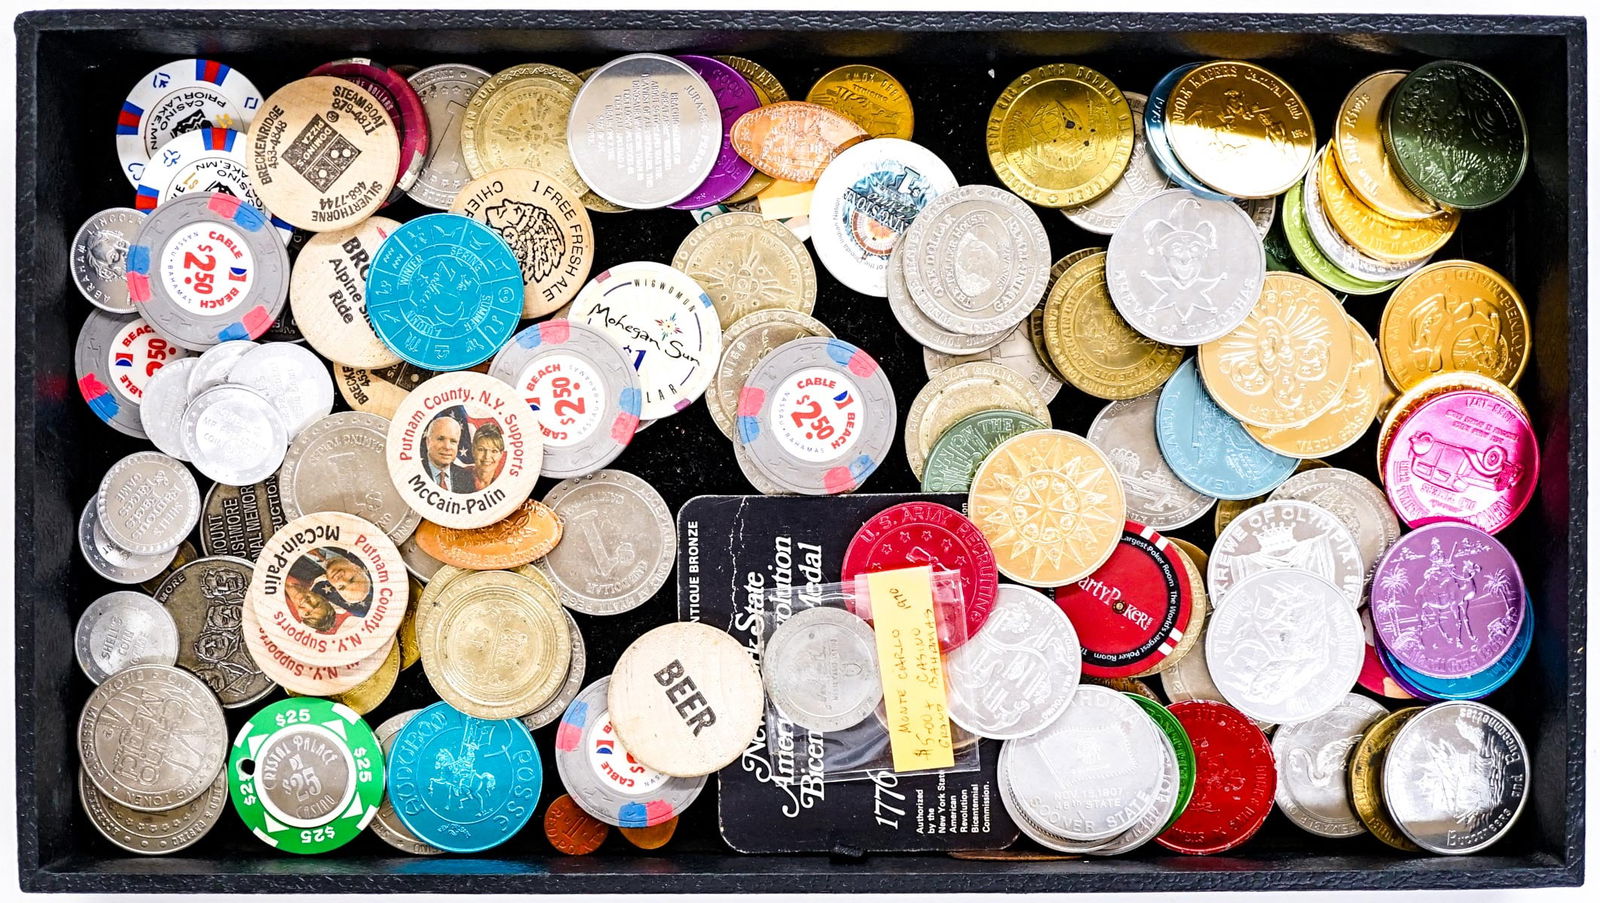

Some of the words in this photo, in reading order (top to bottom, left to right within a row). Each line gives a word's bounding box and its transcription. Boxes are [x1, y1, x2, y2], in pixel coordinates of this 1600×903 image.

[184, 91, 226, 108] PRIOR
[332, 85, 388, 129] STEAMBOAT
[366, 85, 394, 112] DOLLARS
[472, 82, 497, 107] SUN
[160, 99, 204, 131] CASINO
[301, 120, 325, 146] PIZZA
[331, 98, 376, 136] 879-4811
[150, 127, 158, 150] MN
[254, 104, 285, 186] BRECKENRIDGE
[267, 120, 288, 169] 453-4848
[296, 126, 333, 167] DOMINO'S
[196, 160, 218, 171] MN
[311, 180, 384, 223] SILVERTHORNE
[319, 181, 367, 211] 468-7744
[531, 180, 540, 193] 1
[542, 186, 578, 221] FREE
[86, 212, 145, 236] LINCOLN
[208, 230, 243, 260] CABLE
[449, 246, 484, 272] SPRING
[564, 224, 585, 277] FRESH
[328, 257, 363, 304] Alpine
[400, 255, 425, 286] WINTER
[794, 242, 816, 310] MOHEGA
[199, 287, 240, 309] BEACH
[328, 288, 354, 325] Ride
[542, 280, 568, 302] ALE
[465, 294, 492, 333] SUMMER
[587, 302, 662, 351] Mohegan
[664, 340, 702, 367] Sun
[525, 362, 562, 392] BEACH
[795, 376, 837, 390] CABLE
[399, 408, 426, 462] Putnam
[478, 389, 506, 417] N.Y.
[503, 412, 525, 478] Supports
[830, 411, 856, 450] BEACH
[407, 474, 507, 516] McCain-Palin
[1151, 516, 1165, 526] AT
[1167, 510, 1192, 526] THE
[263, 524, 342, 597] McCain-Palin
[352, 533, 391, 584] Putnam
[687, 520, 699, 574] BRONZE
[859, 514, 900, 544] U.S.
[901, 506, 954, 524] ARMY
[956, 524, 993, 624] RECRUITING
[1146, 545, 1166, 566] Poker
[1217, 524, 1249, 601] KREWE
[1249, 506, 1278, 529] OF
[1281, 505, 1352, 563] OLYMPIA
[1161, 564, 1176, 588] Room
[688, 576, 701, 624] NTIQUE
[735, 571, 766, 632] State
[1169, 591, 1179, 606] The
[273, 609, 329, 653] Supports
[1160, 604, 1178, 633] World's
[100, 615, 125, 661] SHELL'S
[332, 633, 363, 654] N.Y.
[890, 629, 908, 679] CARLO
[911, 627, 930, 683] CASINO
[1117, 649, 1141, 662] Poker
[1140, 631, 1166, 656] Largest
[1093, 652, 1118, 663] Room
[653, 658, 718, 738] BEER
[897, 689, 912, 735] MONTE
[274, 708, 312, 728] $25
[262, 736, 299, 793] CRYSTAL
[295, 733, 339, 767] PALACE
[353, 745, 373, 784] $25
[600, 760, 636, 788] CABLE
[937, 769, 946, 793] State
[125, 787, 175, 808] TOKEN
[281, 766, 324, 803] $25
[500, 749, 536, 834] POSSE
[866, 769, 906, 830] 1776
[1510, 772, 1526, 799] and
[295, 793, 337, 820] CASINO
[915, 788, 925, 835] Authorized
[927, 807, 936, 820] the
[937, 793, 947, 816] York
[949, 794, 958, 835] American
[960, 788, 969, 835] Revolution
[970, 783, 980, 835] Bicentennial
[981, 779, 992, 834] Commission.
[1029, 795, 1098, 834] SOONER
[1106, 788, 1151, 828] STATE
[299, 824, 337, 844] $25
[927, 820, 937, 835] by
[937, 816, 947, 835] New
